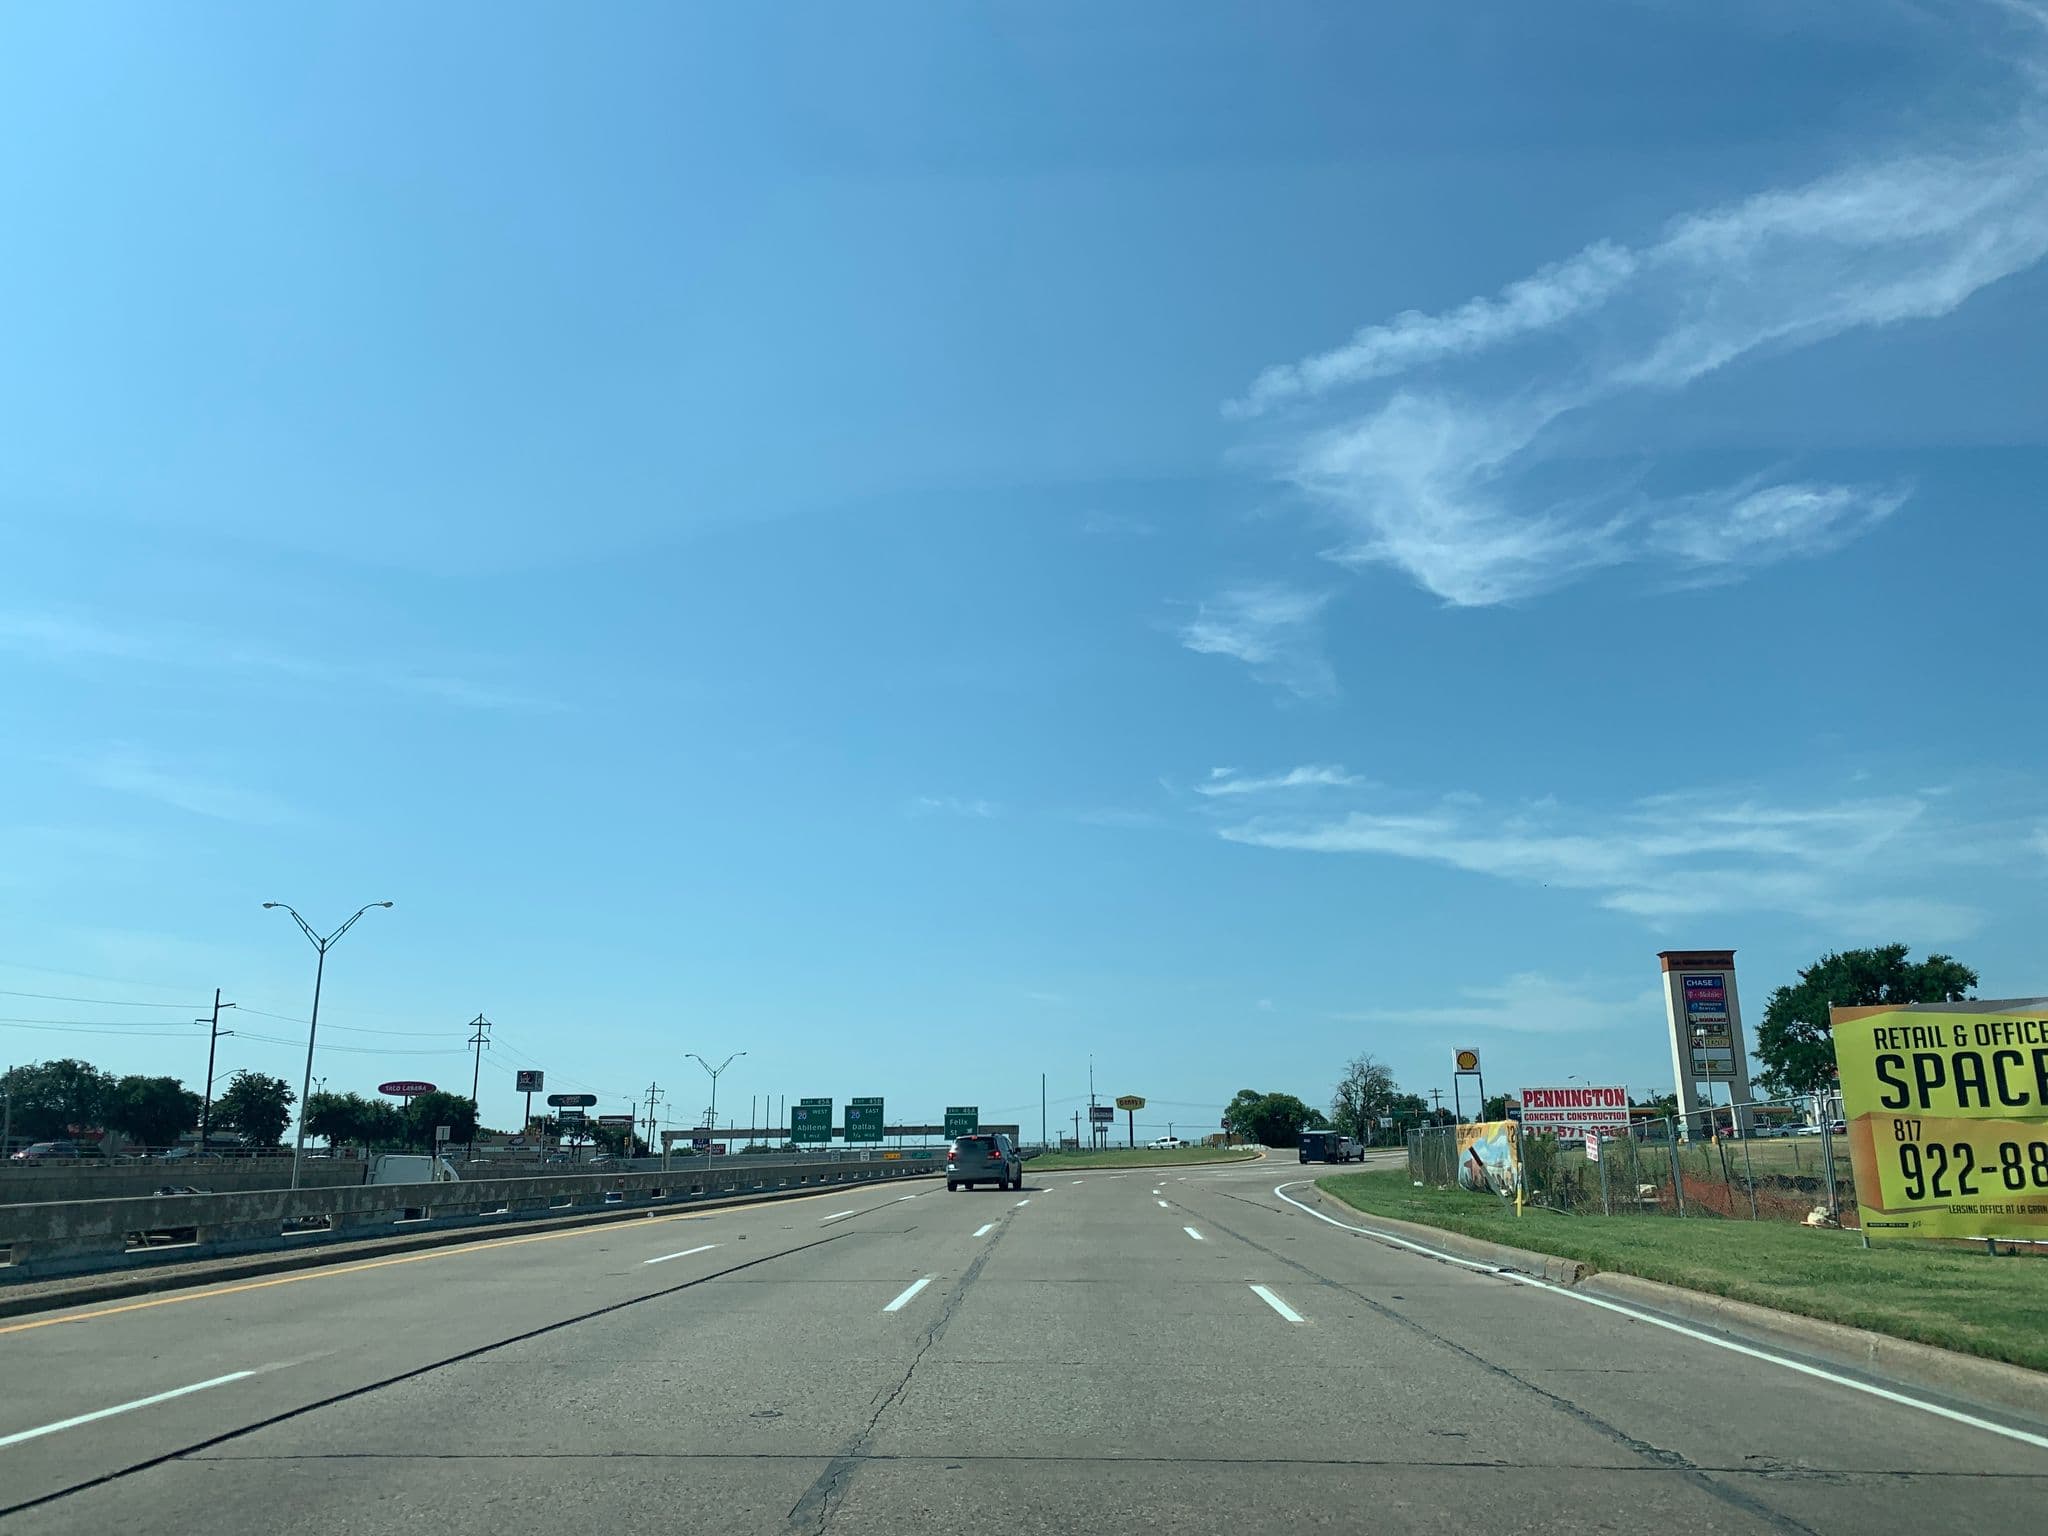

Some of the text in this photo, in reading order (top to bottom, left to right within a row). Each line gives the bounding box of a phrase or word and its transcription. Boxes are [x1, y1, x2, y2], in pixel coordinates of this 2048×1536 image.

[1873, 1020, 2048, 1050] RETAIL & OFFICE
[1522, 1088, 1626, 1108] PENNINGTON
[797, 1112, 807, 1120] 20
[850, 1111, 860, 1119] 20
[1524, 1112, 1564, 1121] CONCRETE
[1567, 1111, 1627, 1121] CONSTRUCTION
[949, 1118, 968, 1126] Felix
[797, 1123, 827, 1132] Abilene
[1893, 1118, 1921, 1142] 817
[1899, 1141, 2048, 1201] 922-88
[1949, 1204, 1979, 1214] LEASING
[1980, 1204, 2004, 1214] OFFICE
[2005, 1204, 2016, 1214] AT
[2016, 1204, 2027, 1214] LA
